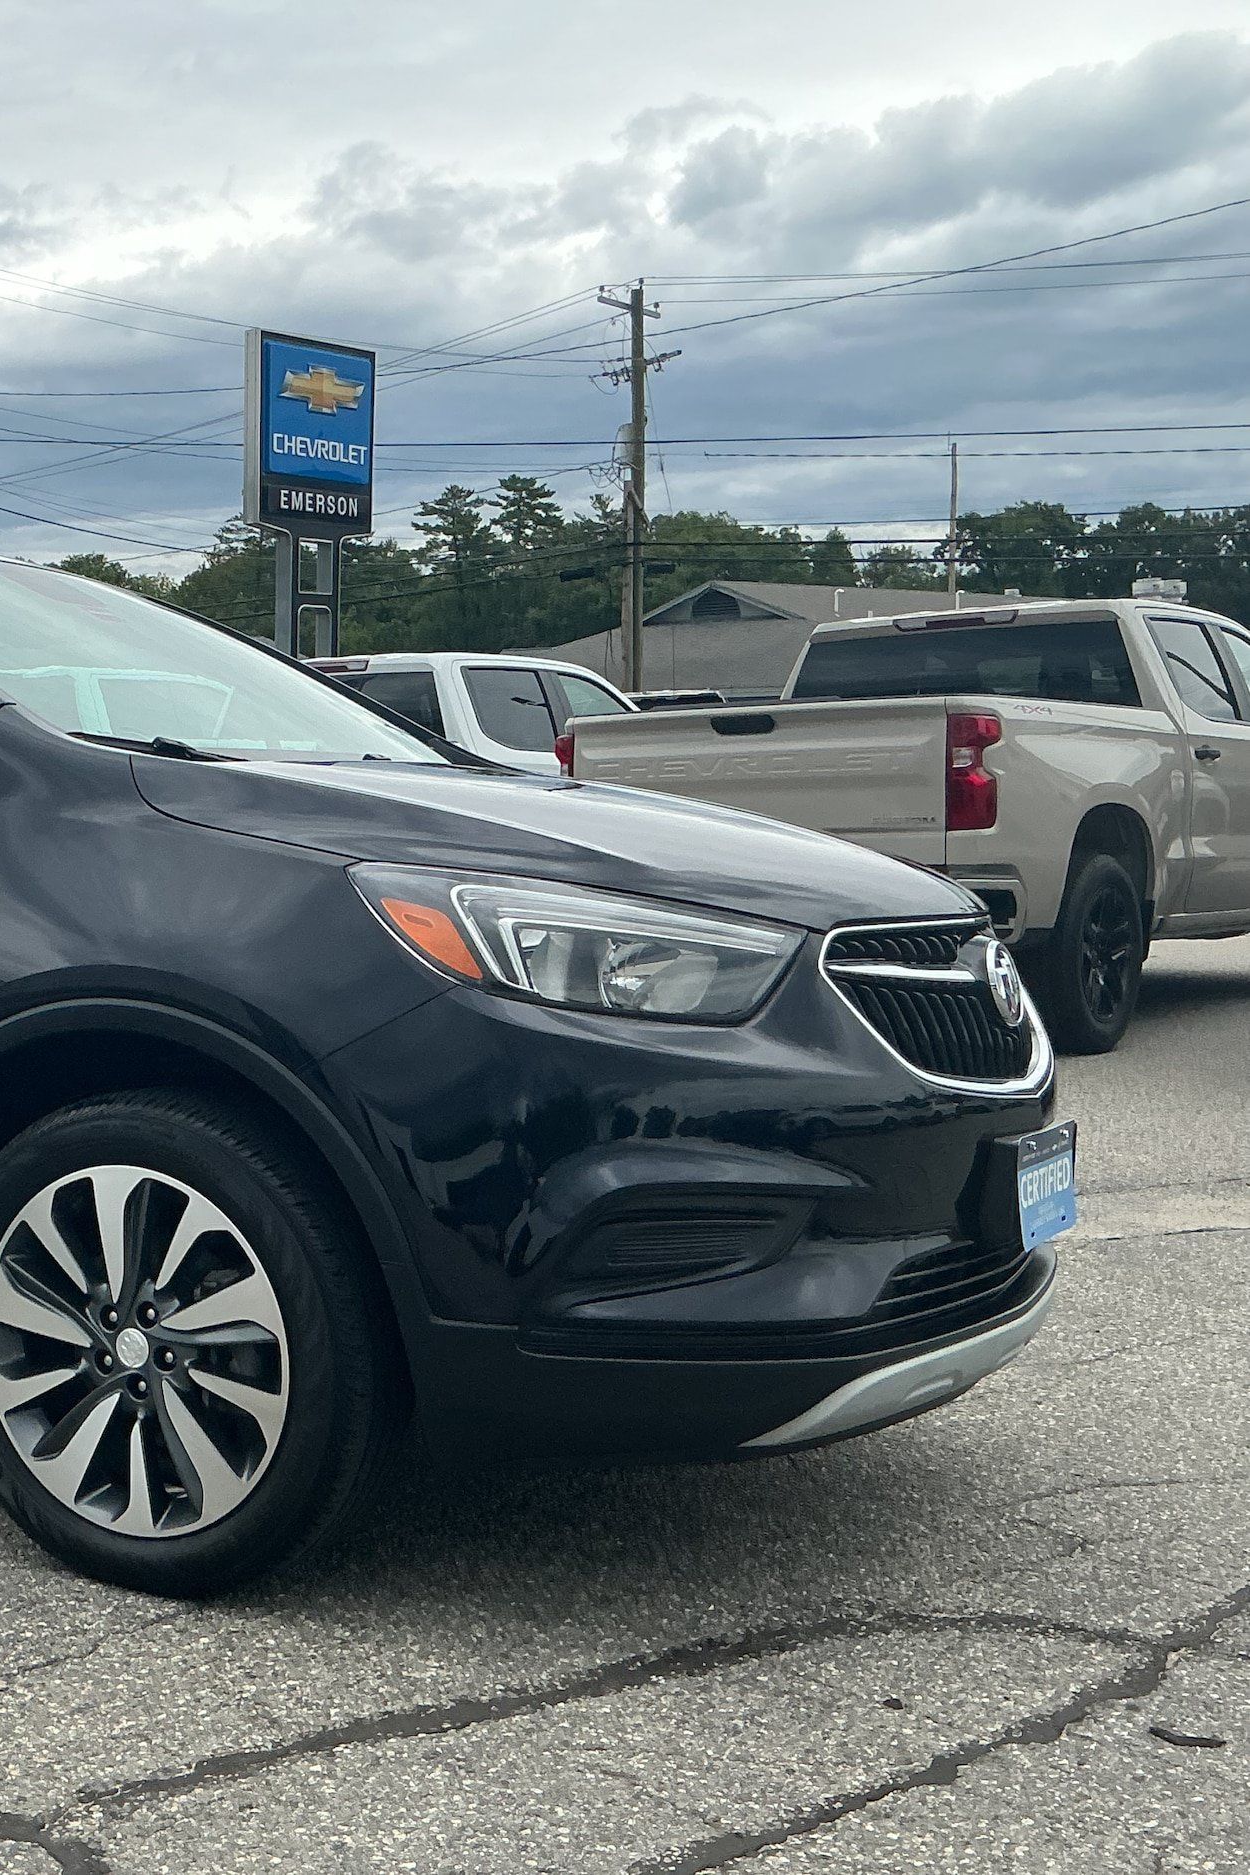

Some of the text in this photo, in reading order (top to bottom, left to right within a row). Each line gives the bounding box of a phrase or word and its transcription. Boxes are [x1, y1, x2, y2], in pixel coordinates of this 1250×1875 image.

[272, 433, 367, 465] CHEVROLET
[280, 490, 358, 517] EMERSON
[1020, 1157, 1071, 1209] CERTIFIED
